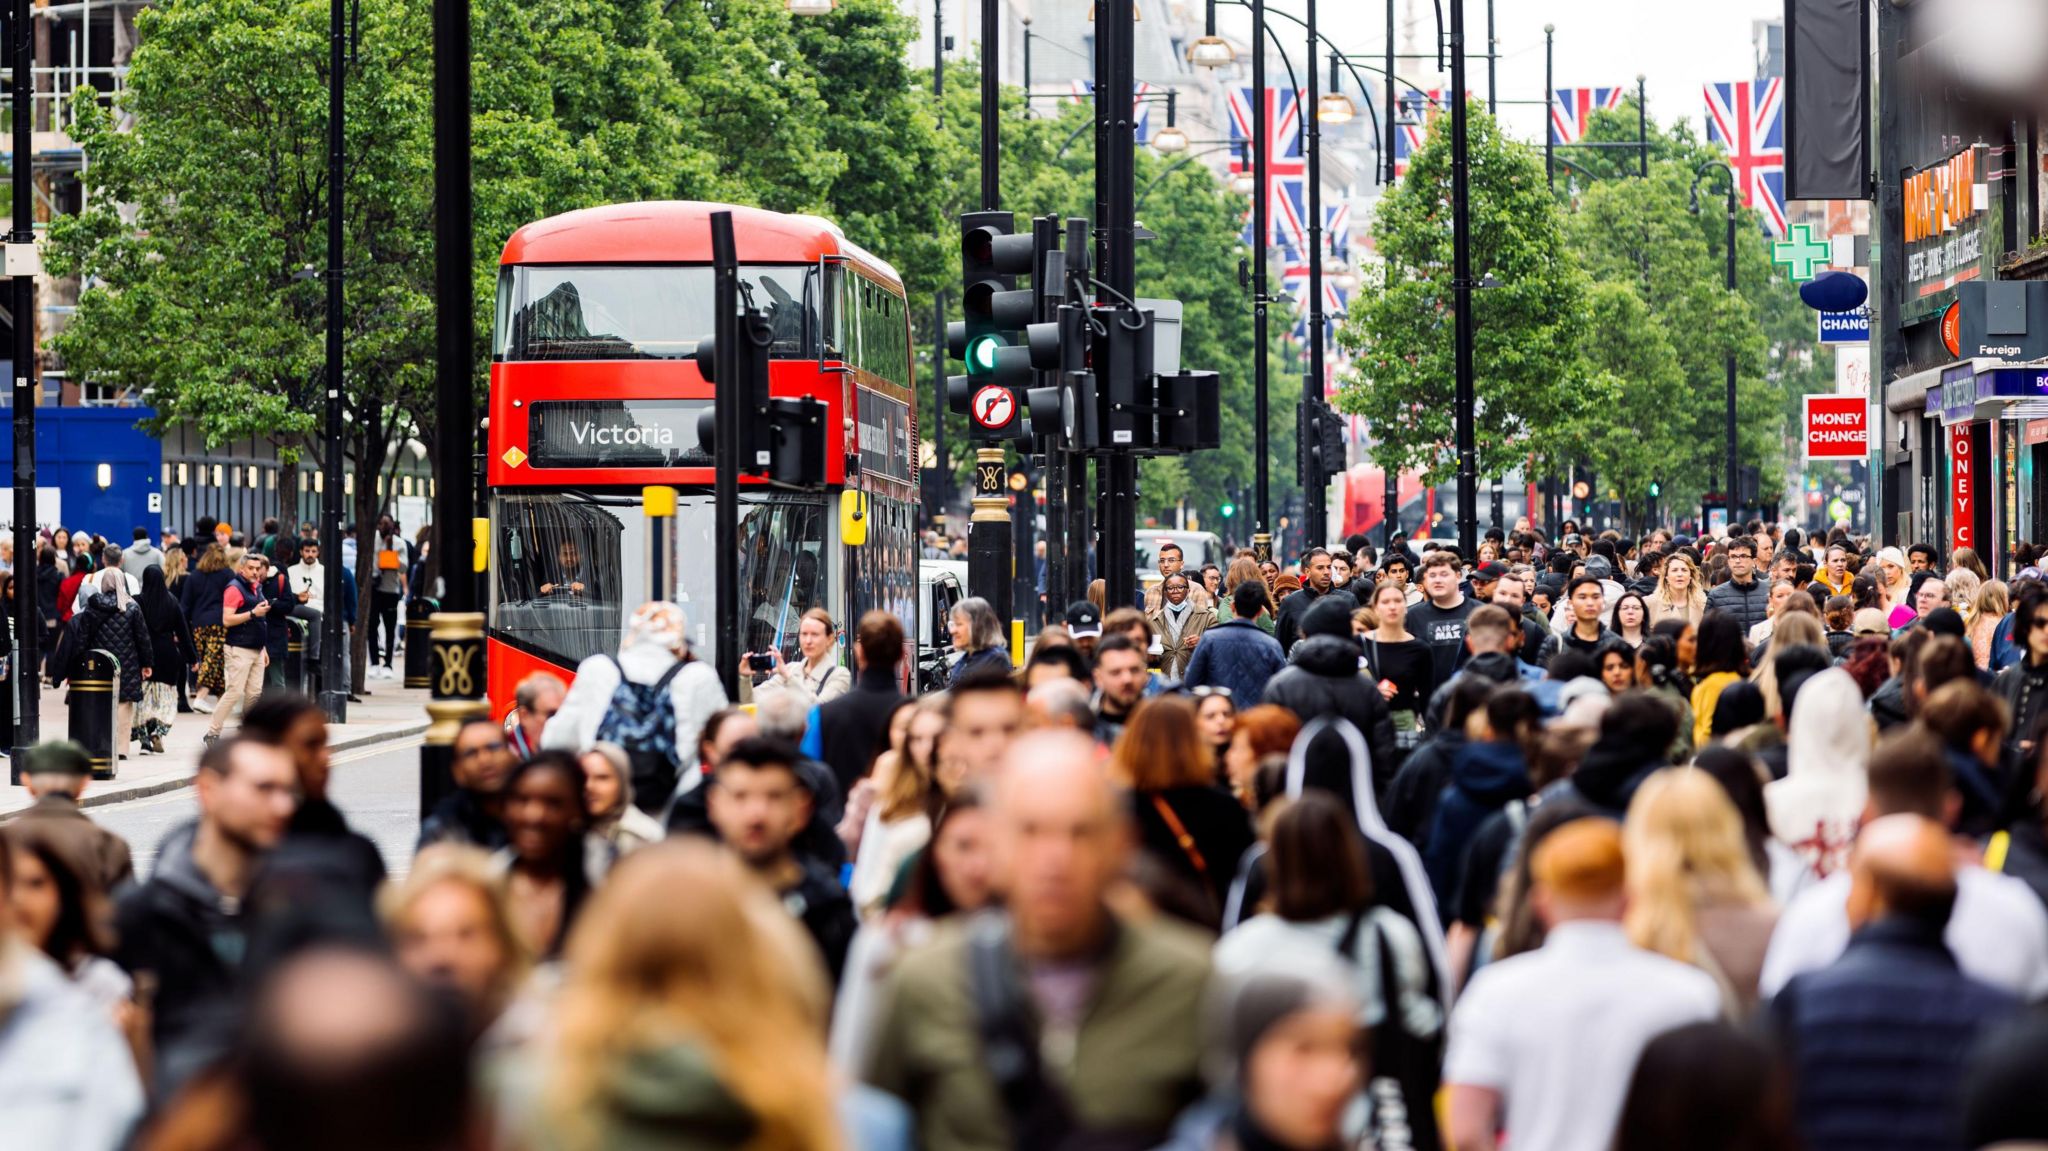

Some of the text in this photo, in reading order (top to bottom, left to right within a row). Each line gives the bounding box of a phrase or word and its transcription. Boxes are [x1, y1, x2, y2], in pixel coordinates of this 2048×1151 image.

[1822, 318, 1869, 330] CHANG
[1979, 345, 2021, 356] Foreign
[1811, 413, 1862, 425] MONEY
[570, 421, 673, 445] Victoria
[1809, 430, 1867, 443] CHANGE
[1955, 423, 1969, 513] MONEY
[1435, 625, 1451, 633] AIR
[1435, 631, 1461, 640] MAX
